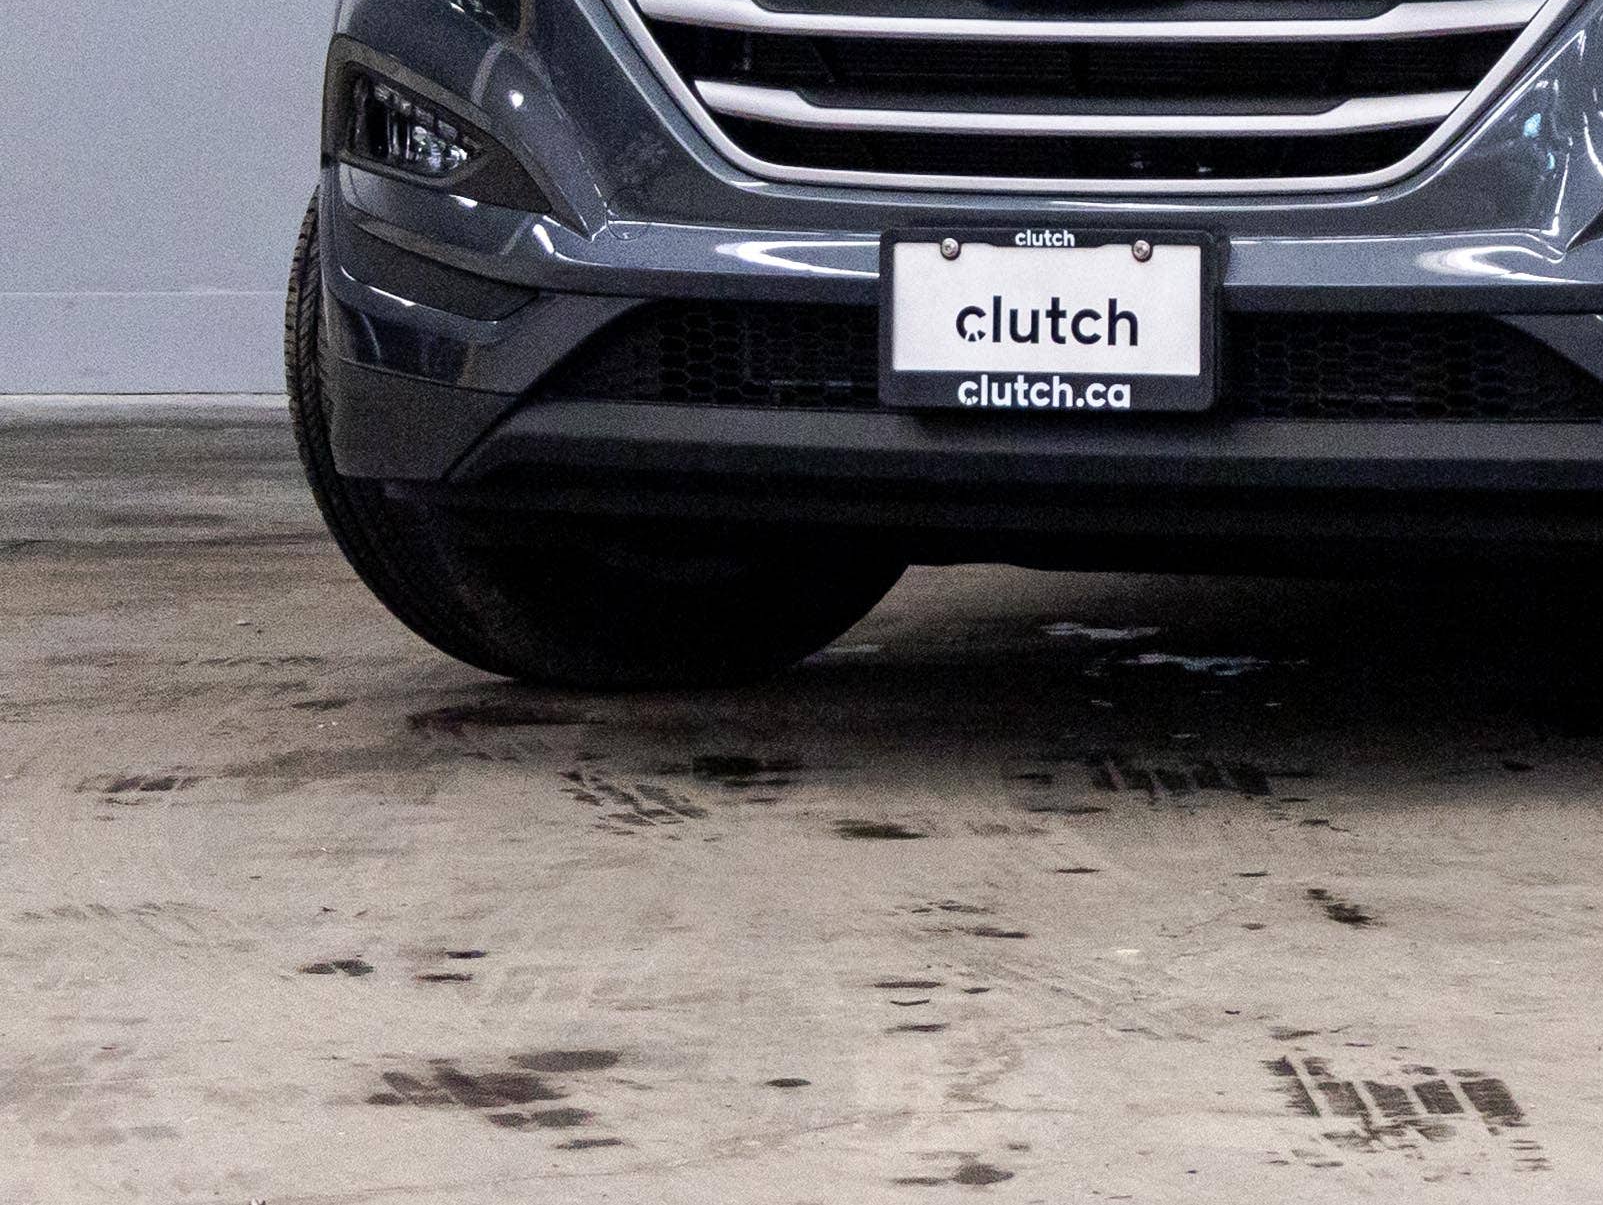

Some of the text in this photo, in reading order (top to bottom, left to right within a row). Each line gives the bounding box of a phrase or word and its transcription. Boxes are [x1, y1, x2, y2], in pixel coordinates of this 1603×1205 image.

[1015, 229, 1075, 246] clutch
[956, 296, 1137, 346] clutch
[958, 374, 1131, 409] clutch.ca
